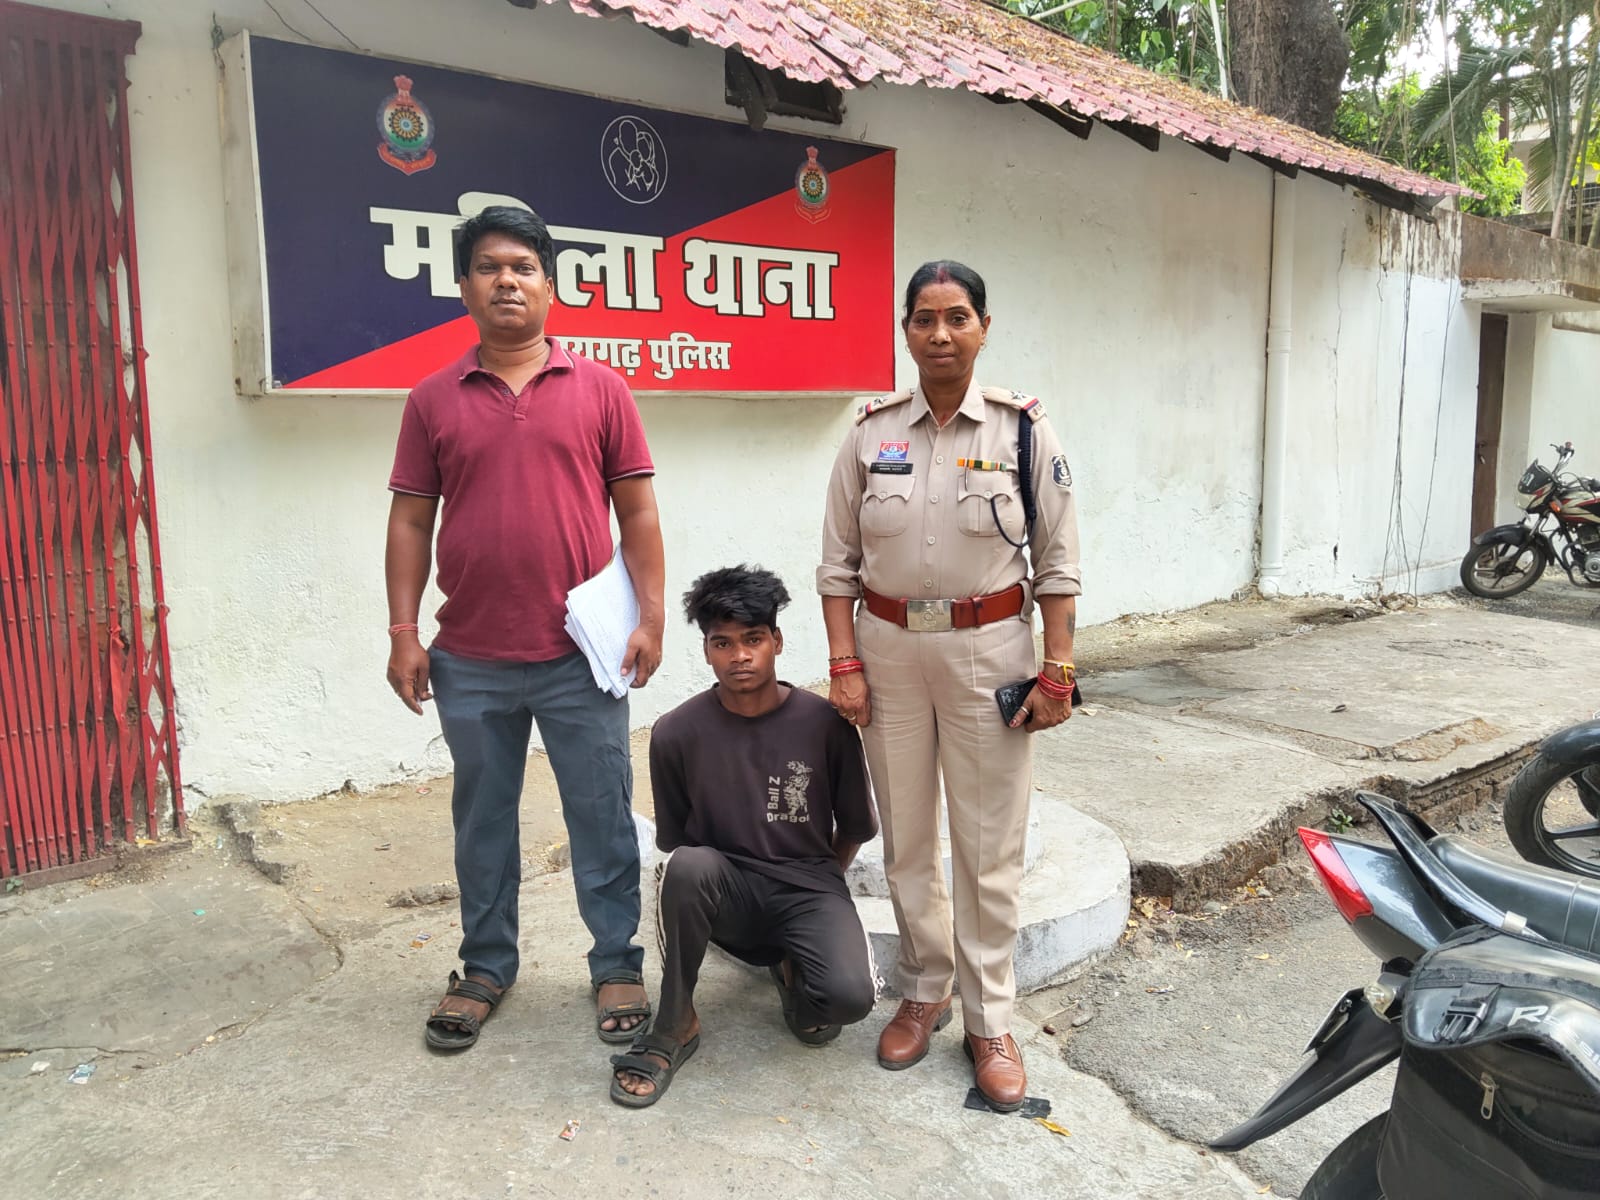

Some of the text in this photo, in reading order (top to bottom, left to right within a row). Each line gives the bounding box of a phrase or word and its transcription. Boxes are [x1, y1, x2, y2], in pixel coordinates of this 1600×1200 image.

[683, 237, 840, 321] थाना
[646, 331, 732, 380] पुलिस
[767, 775, 781, 810] Ball Z
